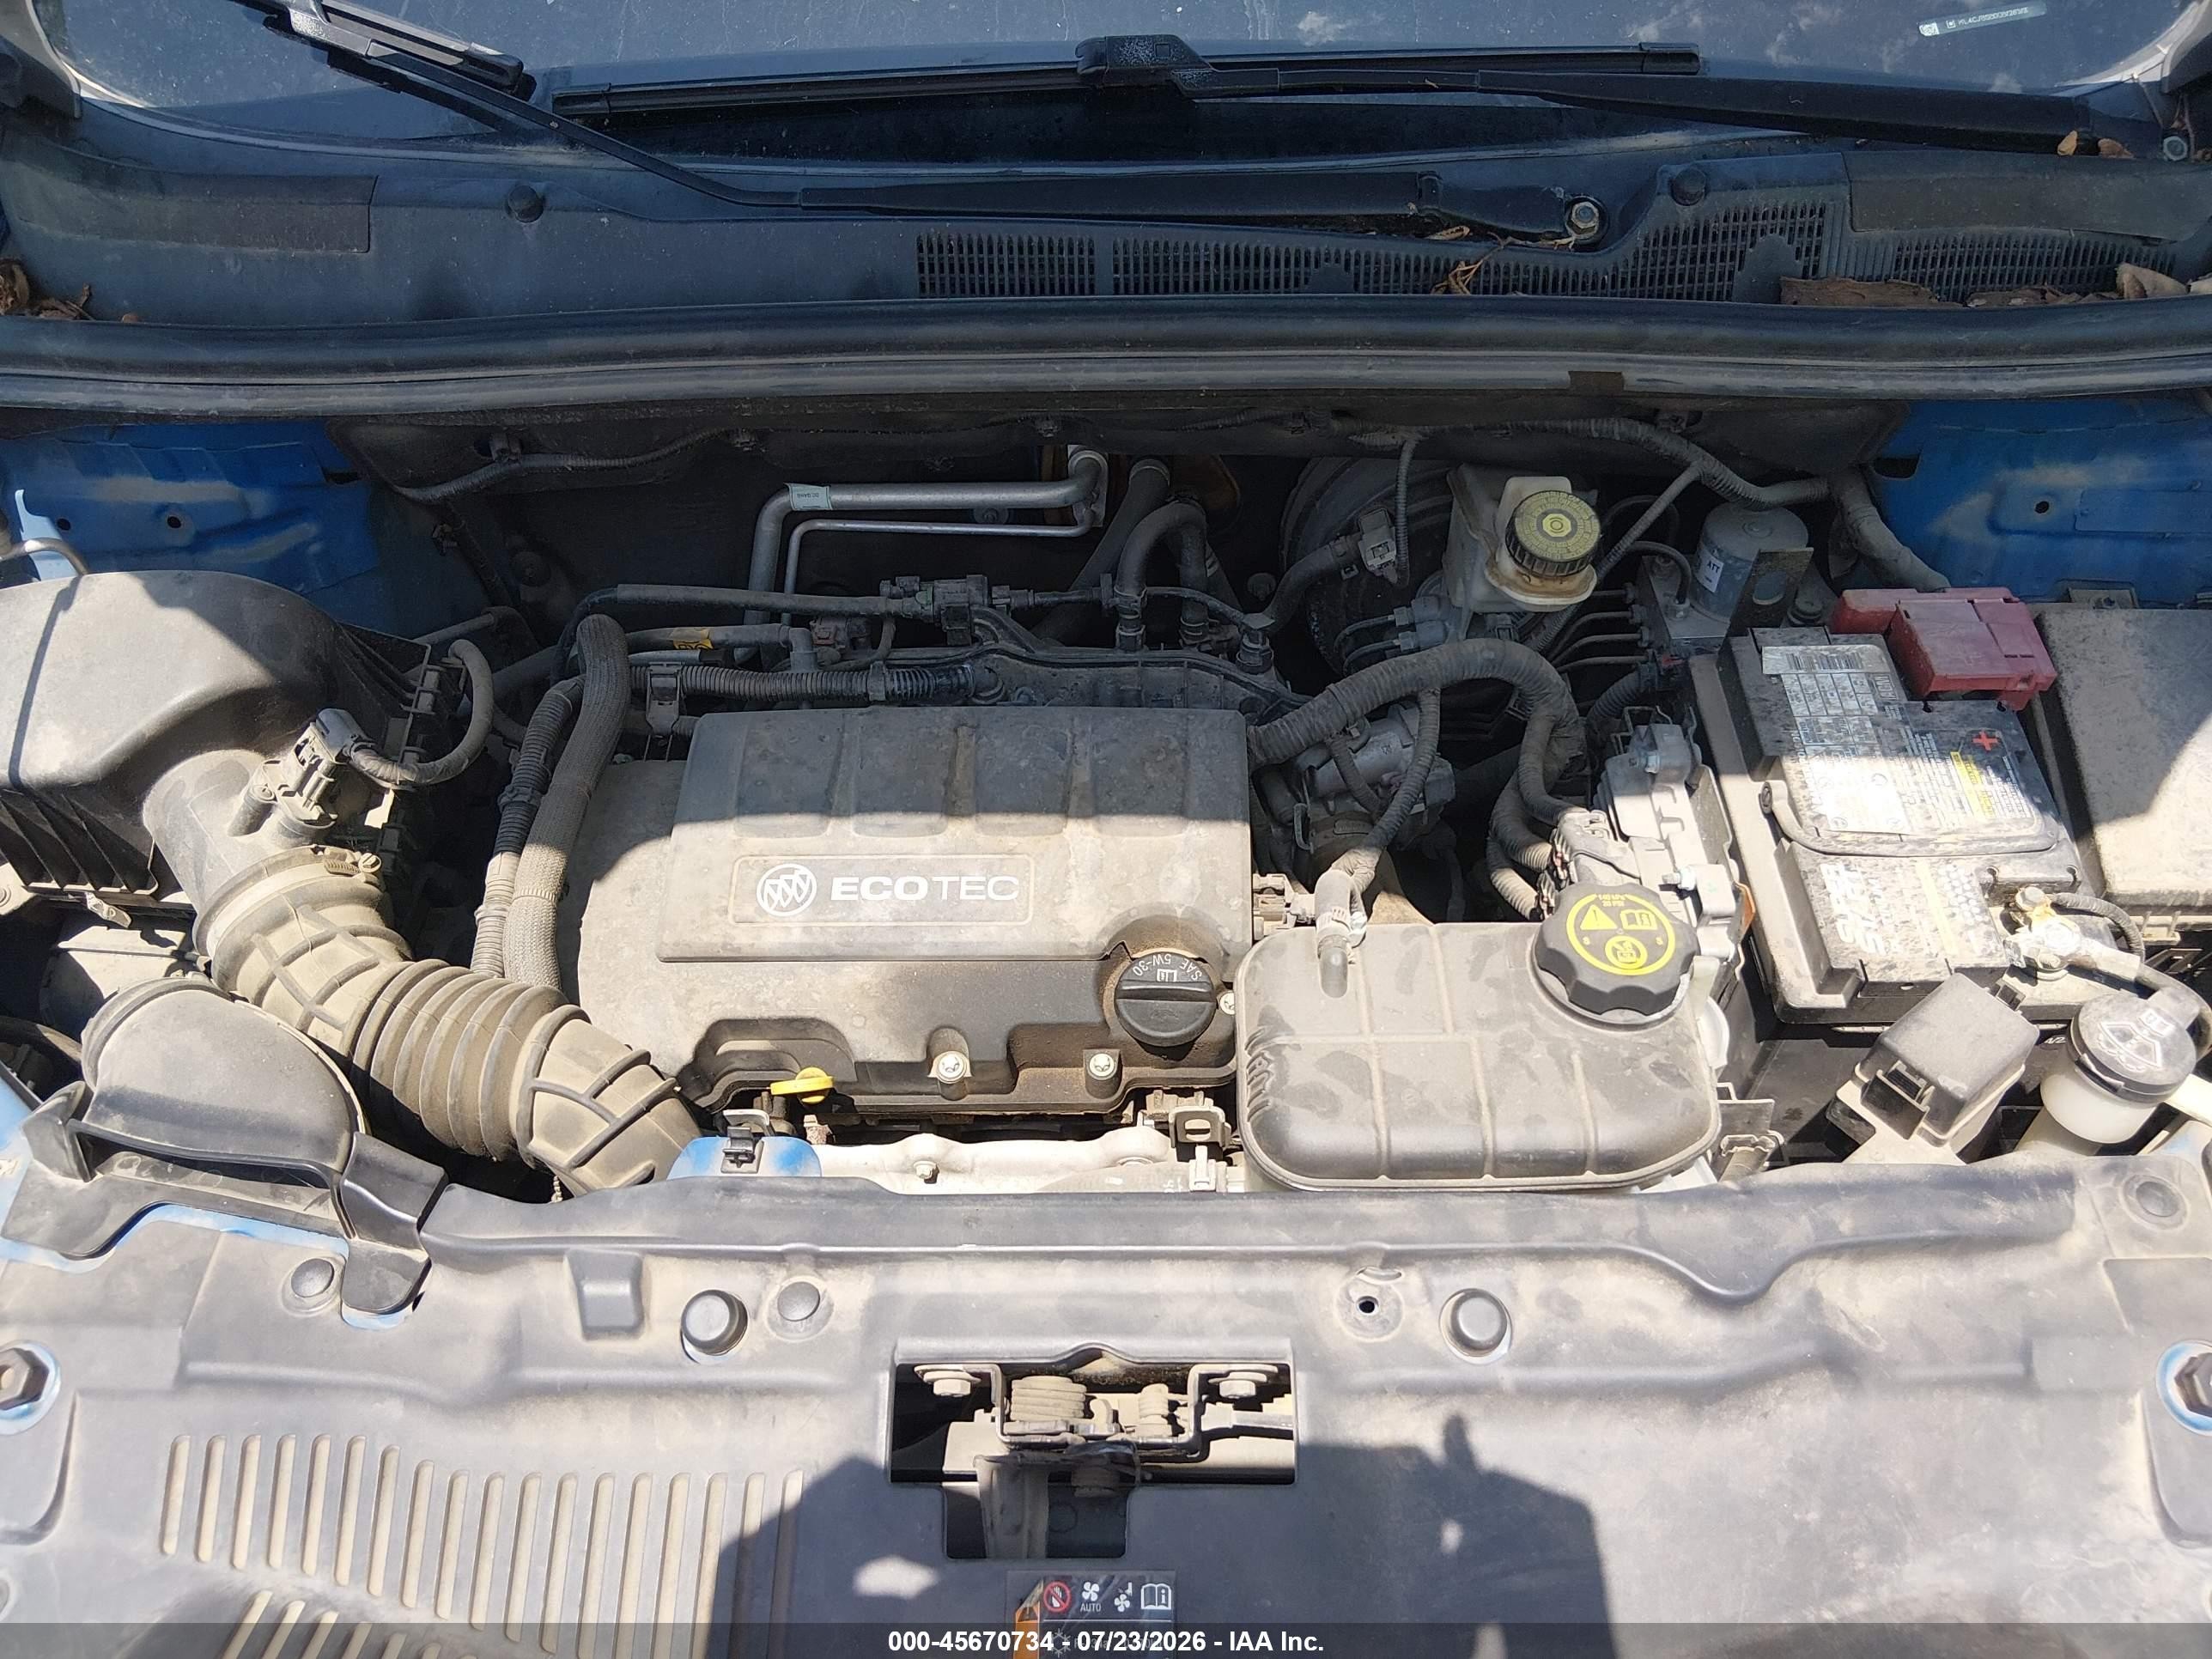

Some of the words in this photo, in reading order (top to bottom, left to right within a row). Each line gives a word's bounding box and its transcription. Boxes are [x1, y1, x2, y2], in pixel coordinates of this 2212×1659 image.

[830, 875, 1019, 901] ECOTEC
[1133, 953, 1172, 977] 5W-30
[1179, 958, 1203, 981] SAE
[1080, 1603, 1101, 1613] AUTO
